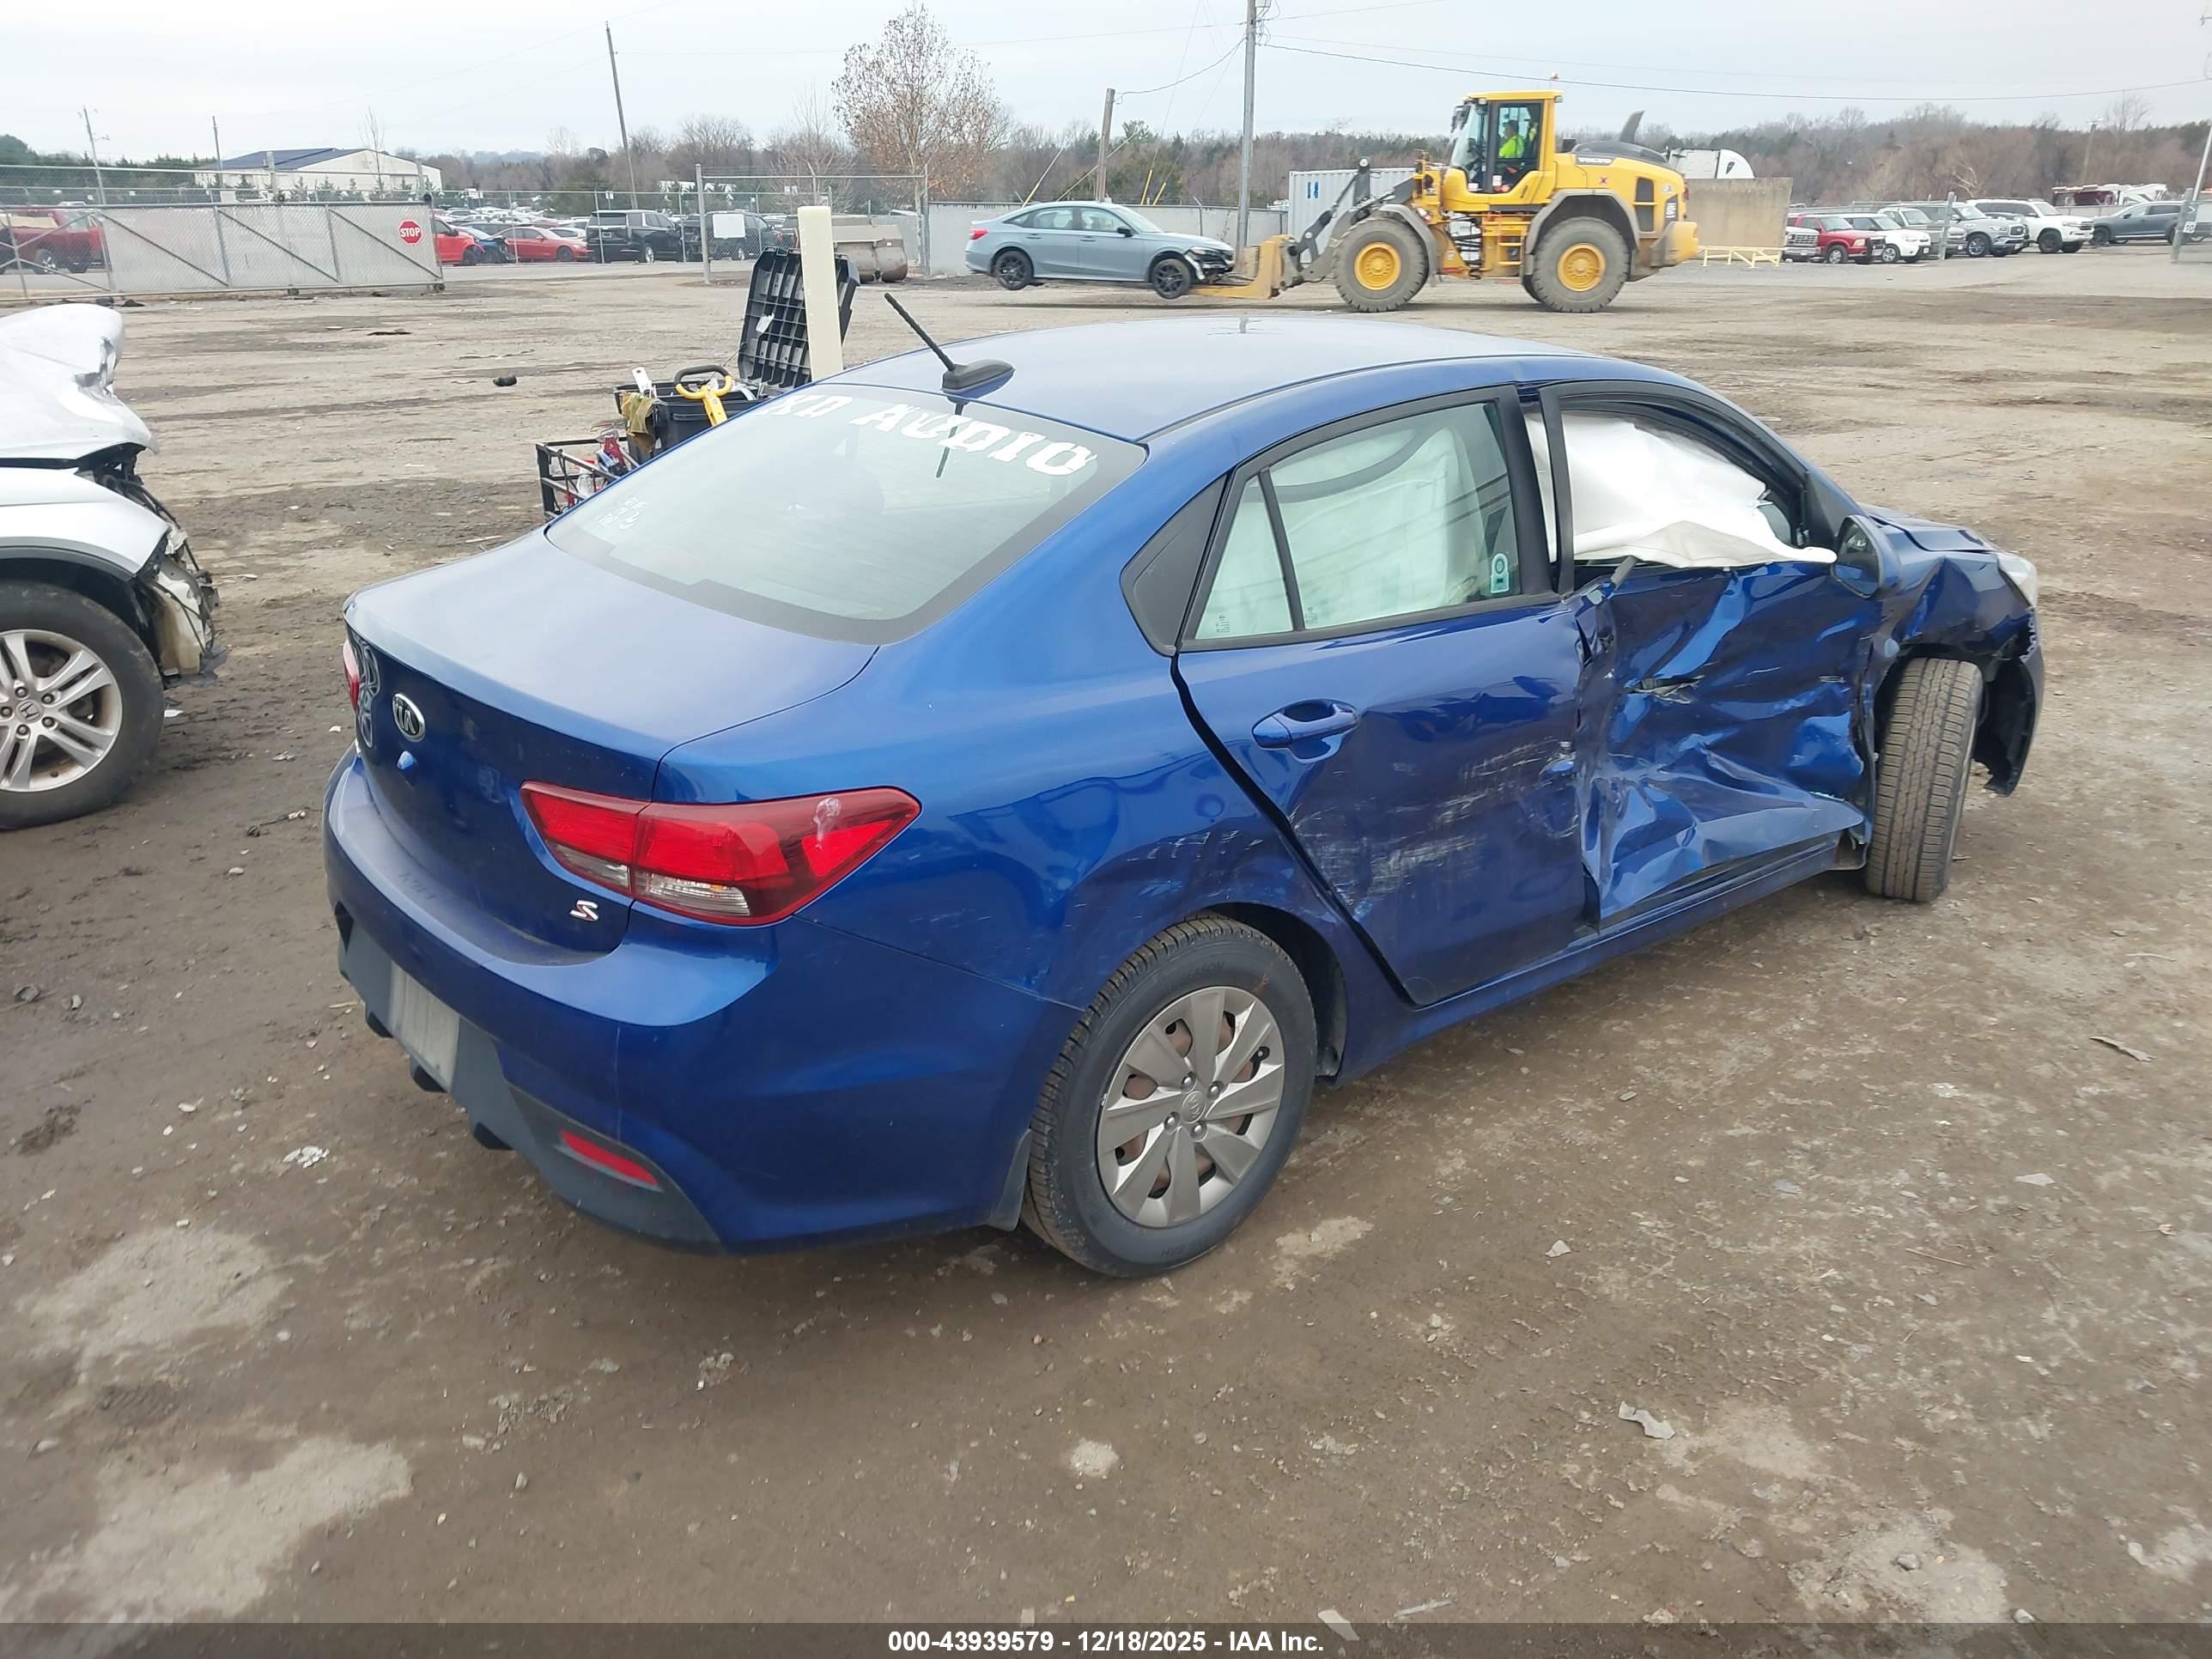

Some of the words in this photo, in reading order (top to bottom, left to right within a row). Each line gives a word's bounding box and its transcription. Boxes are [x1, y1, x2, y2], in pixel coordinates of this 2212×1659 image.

[400, 228, 421, 238] STOP
[849, 404, 1097, 476] AUDIO
[570, 900, 599, 921] S
